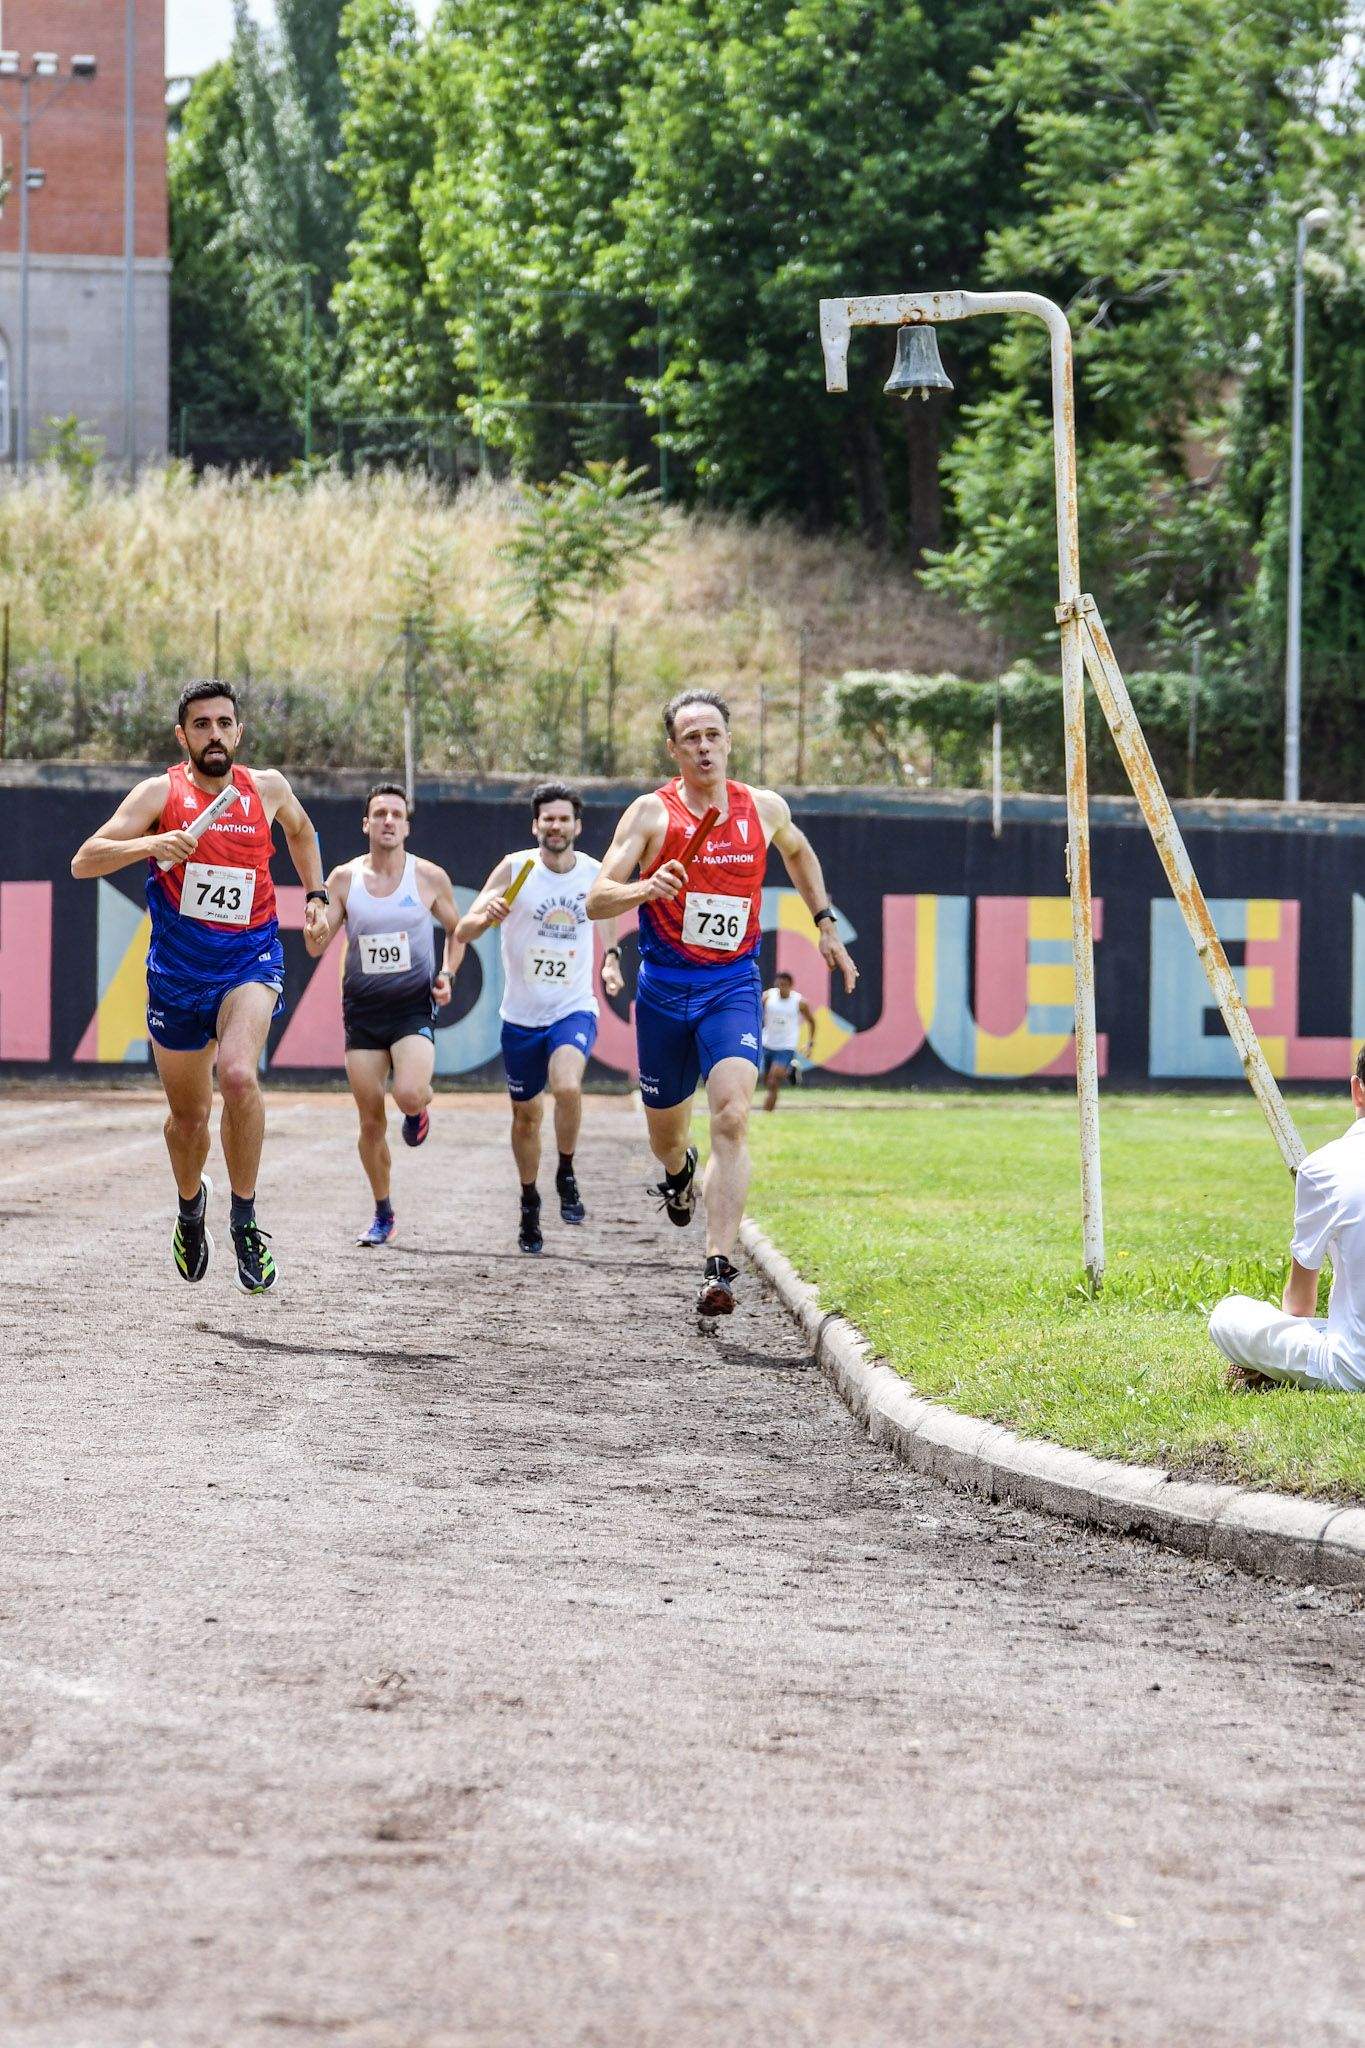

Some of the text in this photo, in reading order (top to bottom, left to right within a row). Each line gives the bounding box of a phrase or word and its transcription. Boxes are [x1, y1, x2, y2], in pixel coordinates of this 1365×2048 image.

[702, 854, 754, 865] MARATHON
[196, 882, 242, 911] 743
[697, 911, 739, 938] 736
[368, 946, 401, 964] 799
[533, 958, 567, 978] 732
